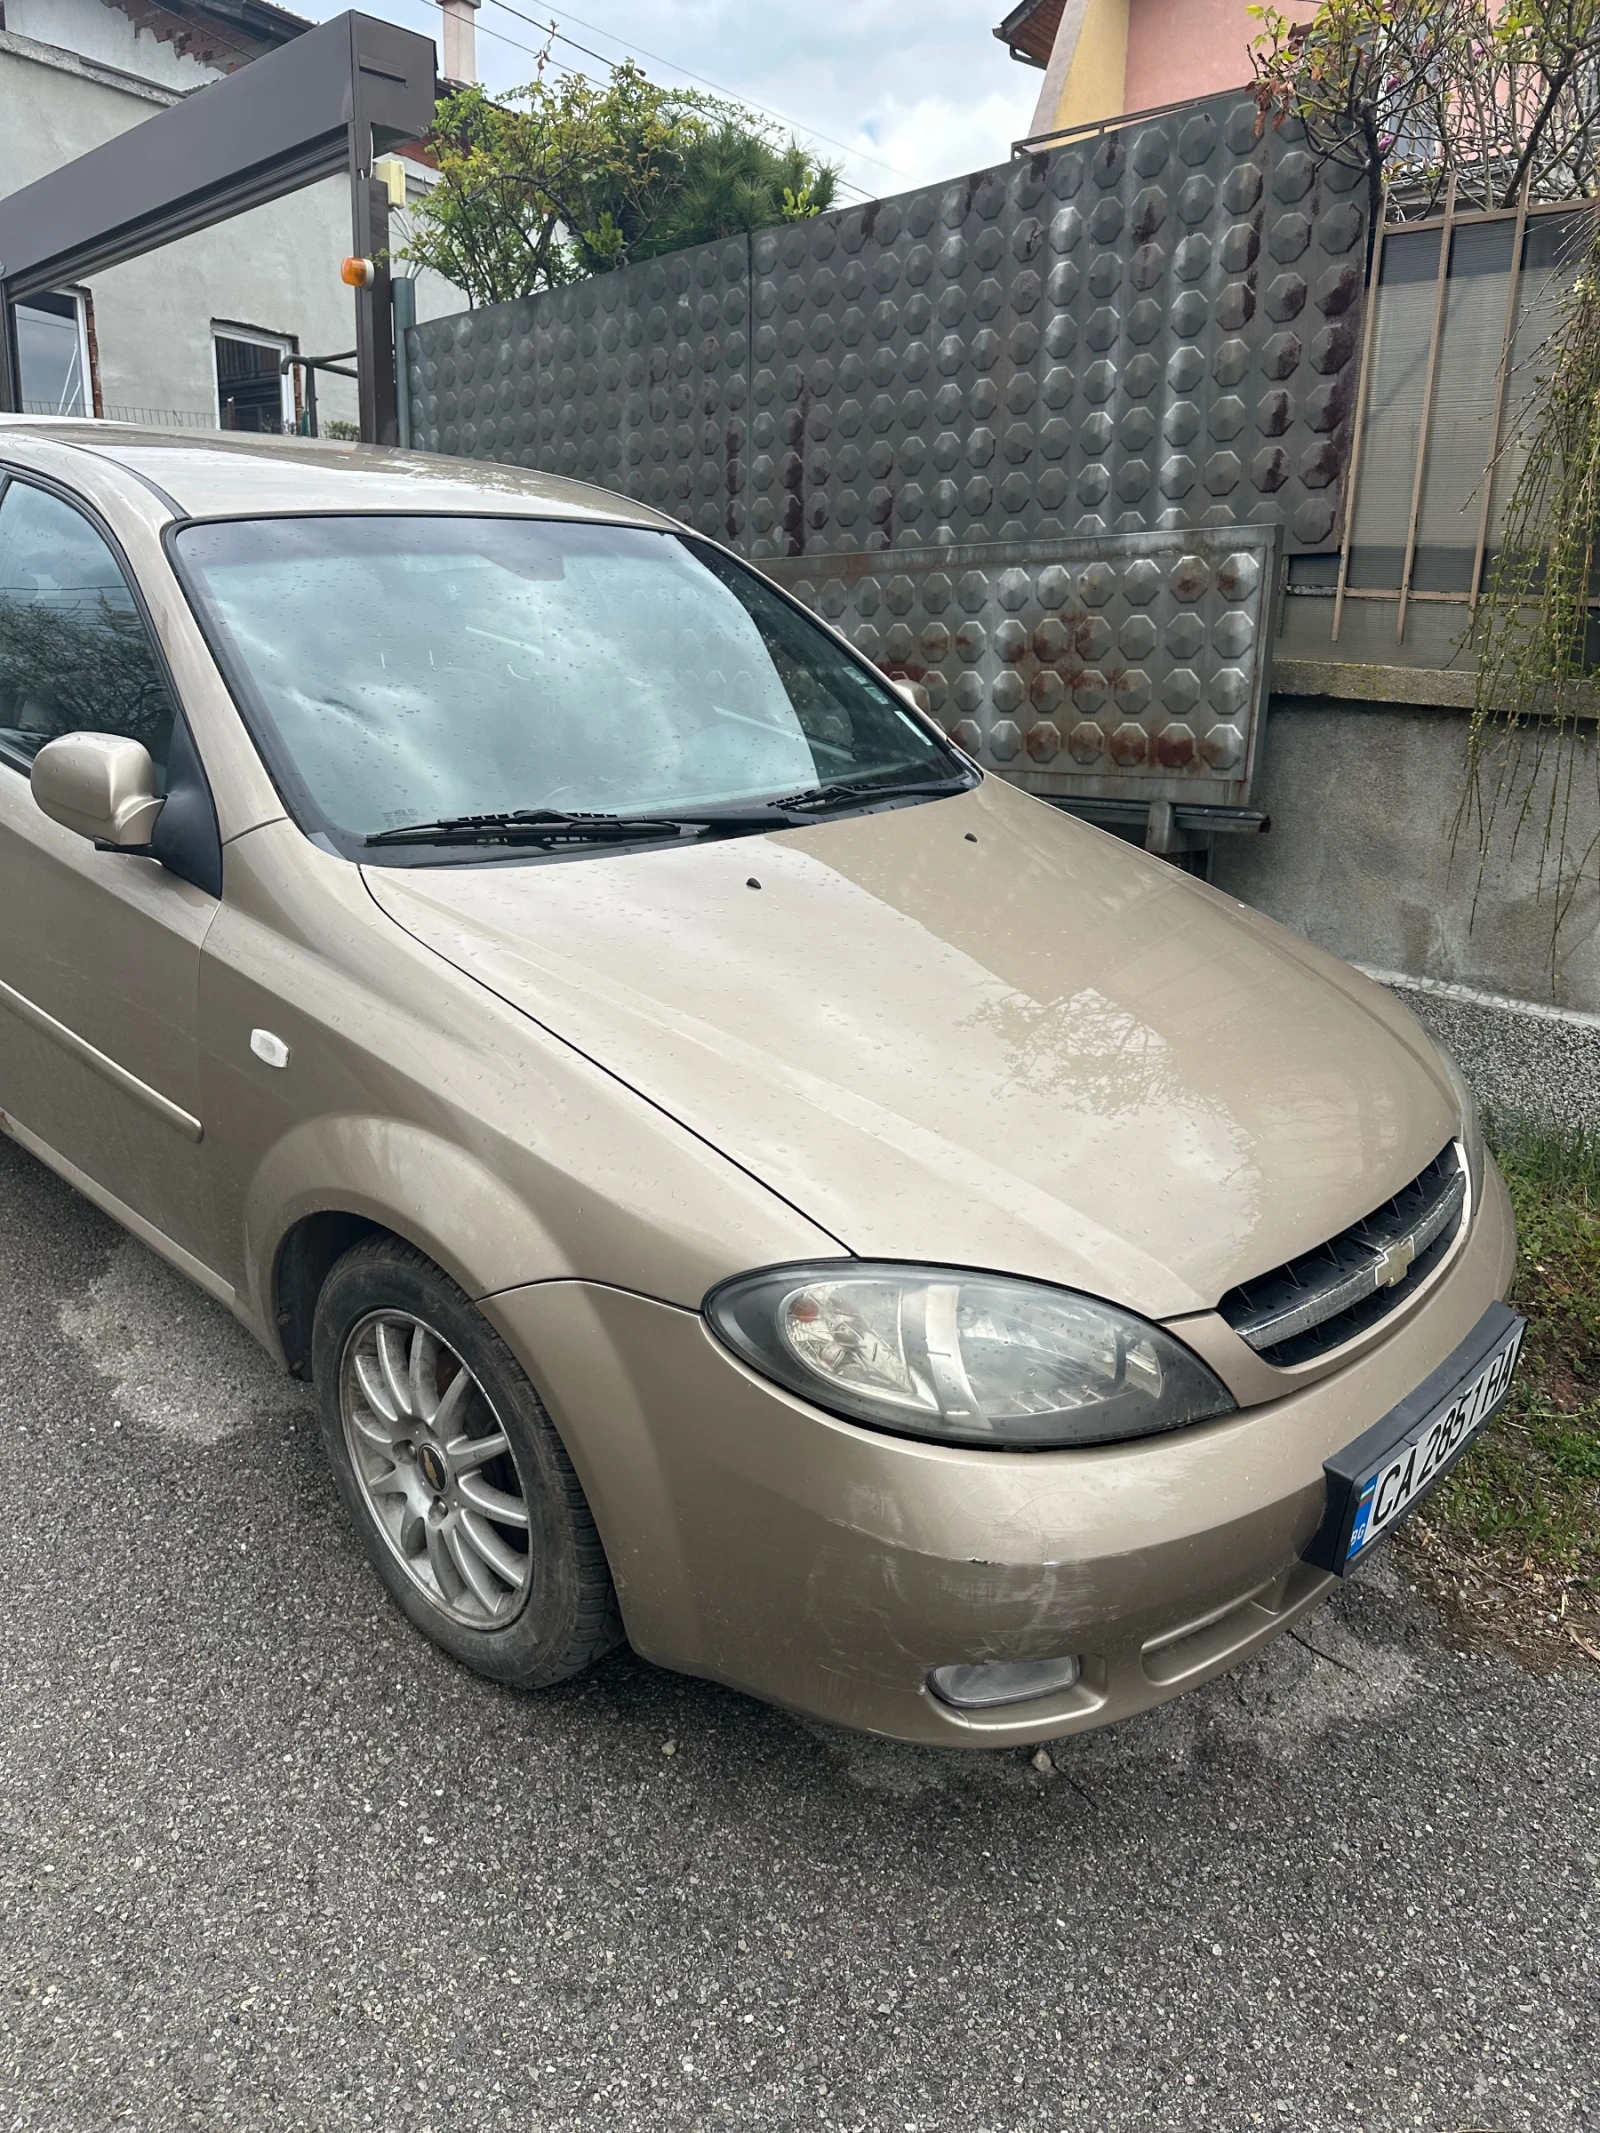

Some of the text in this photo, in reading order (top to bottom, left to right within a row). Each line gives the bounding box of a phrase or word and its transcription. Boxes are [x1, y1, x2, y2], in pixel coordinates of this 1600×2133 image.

[1373, 1340, 1515, 1526] CA 2851 HA
[1350, 1522, 1366, 1547] BG
